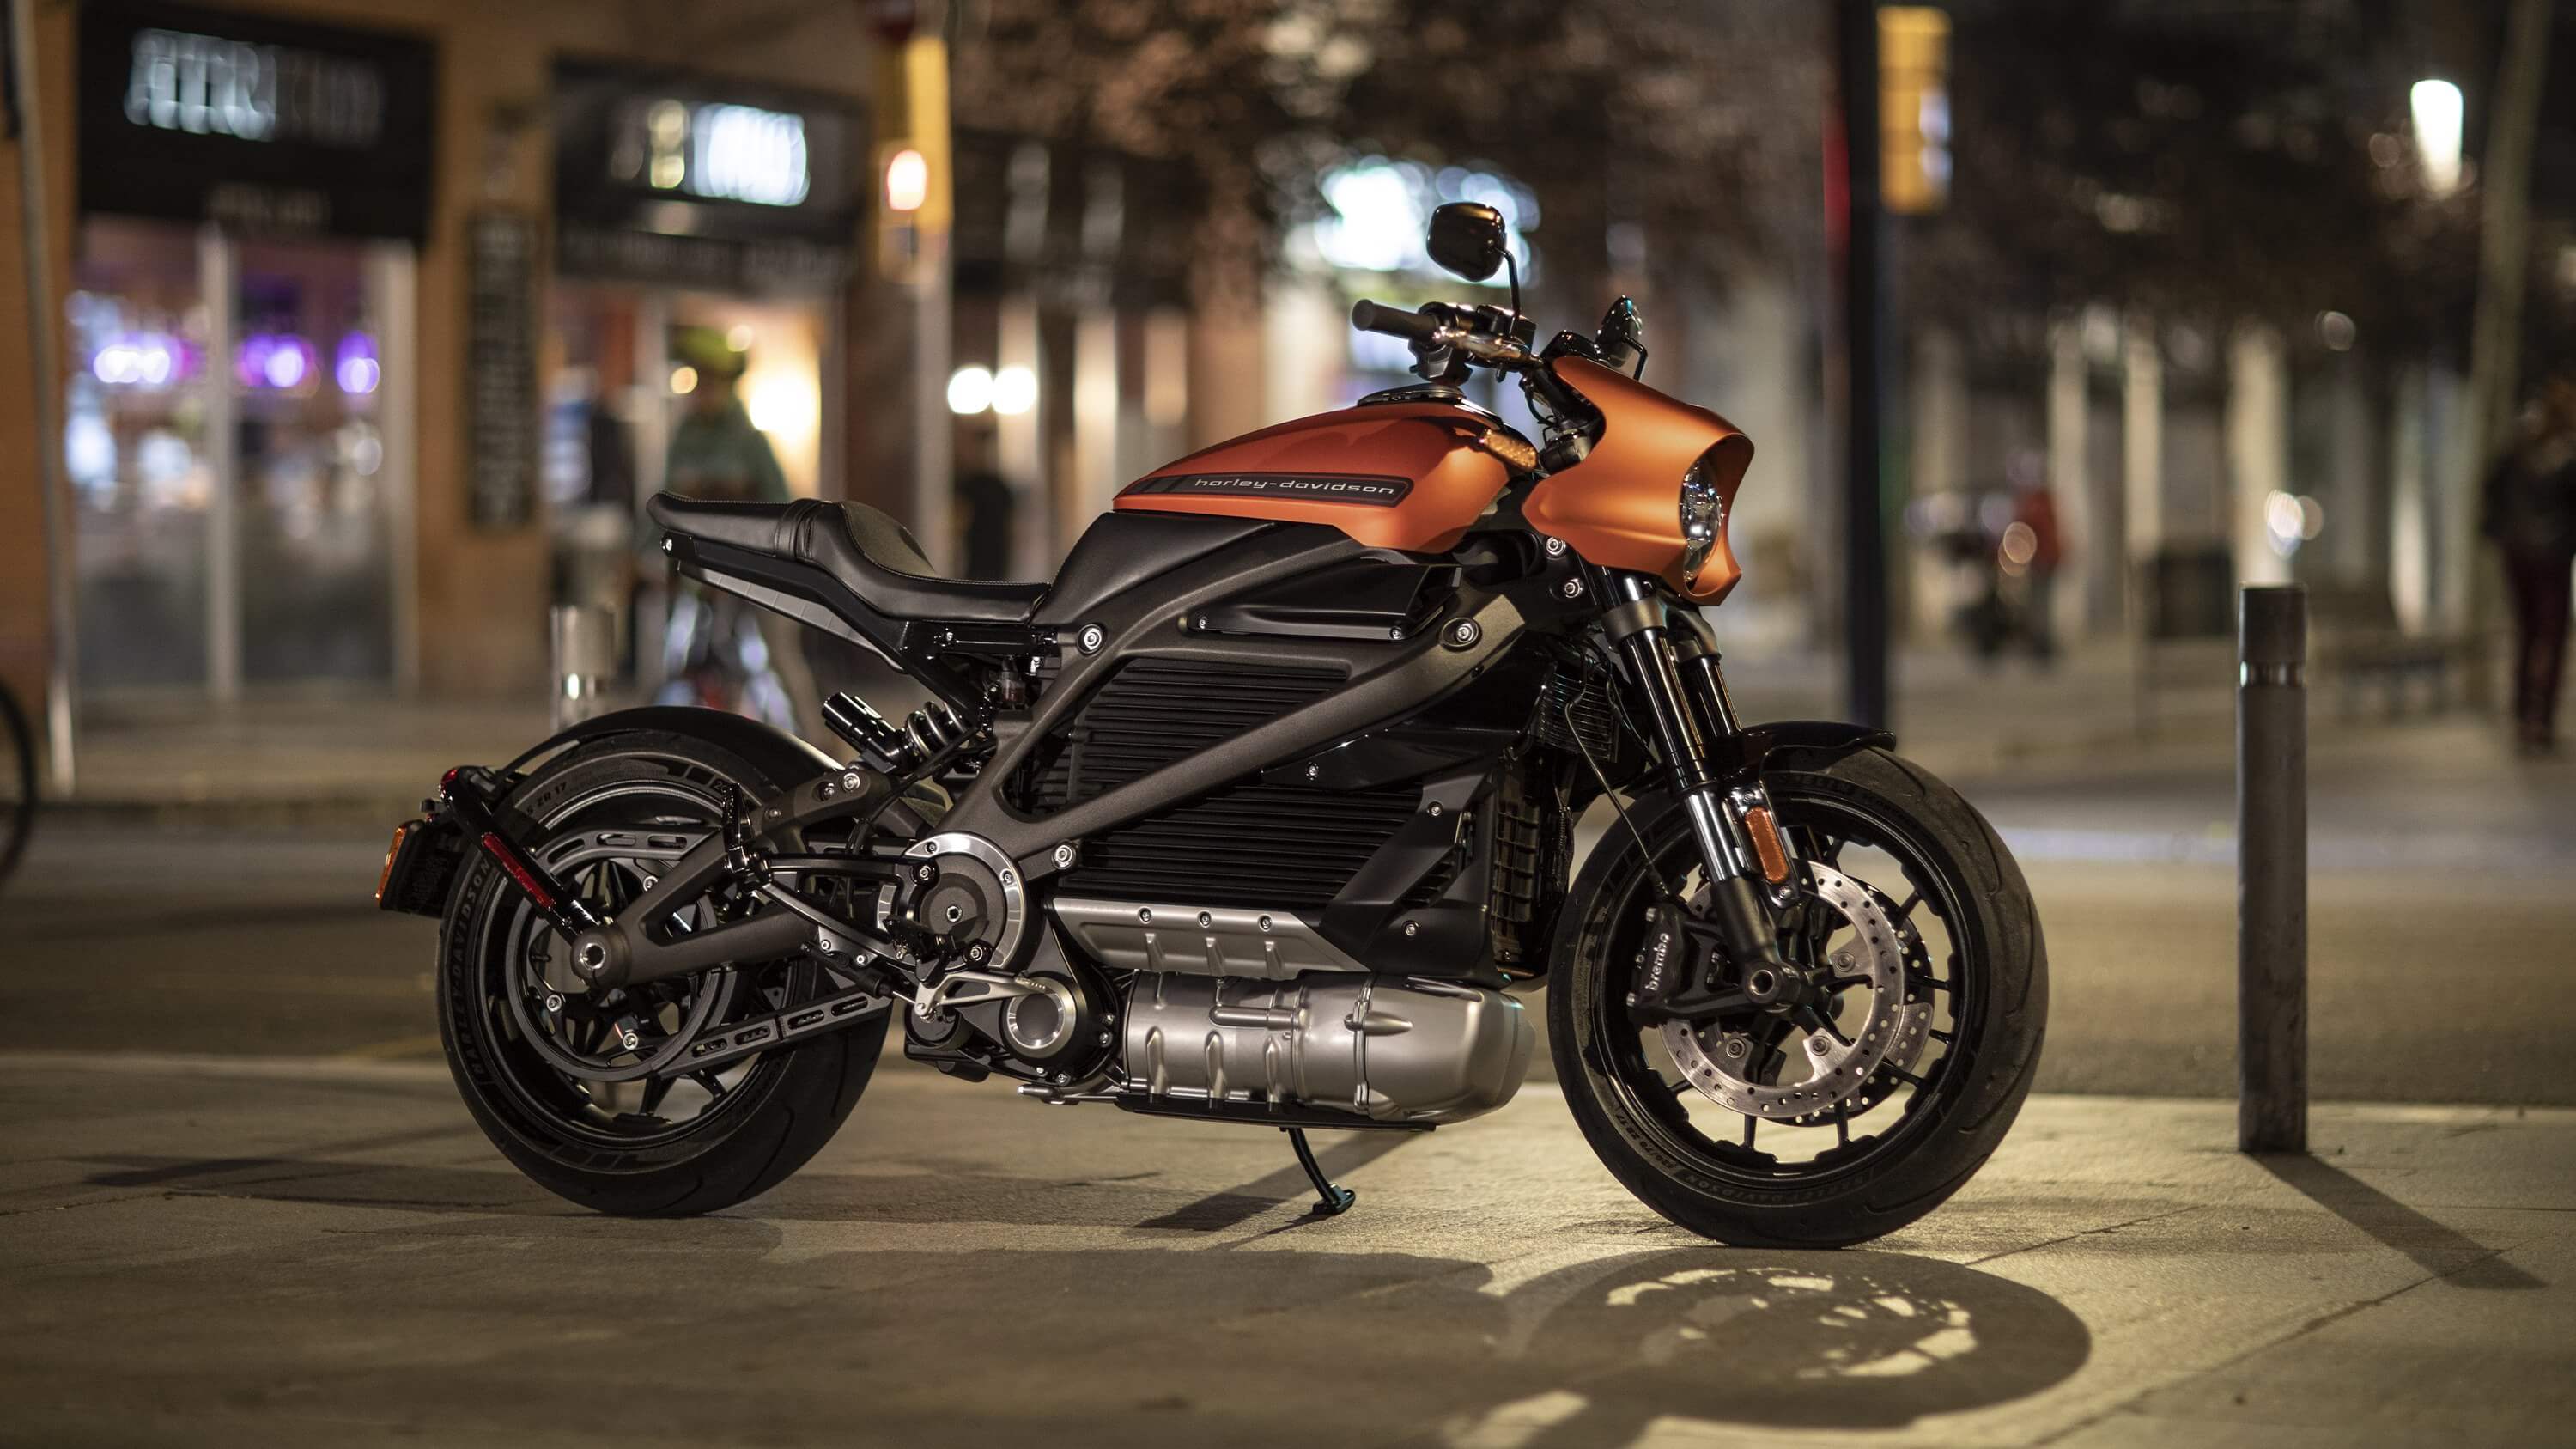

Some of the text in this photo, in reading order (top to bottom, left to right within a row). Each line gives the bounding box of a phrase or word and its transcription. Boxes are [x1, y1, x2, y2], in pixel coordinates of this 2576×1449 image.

[1194, 478, 1395, 495] harley-davidson
[555, 782, 567, 794] 17
[1645, 933, 1670, 991] brembo
